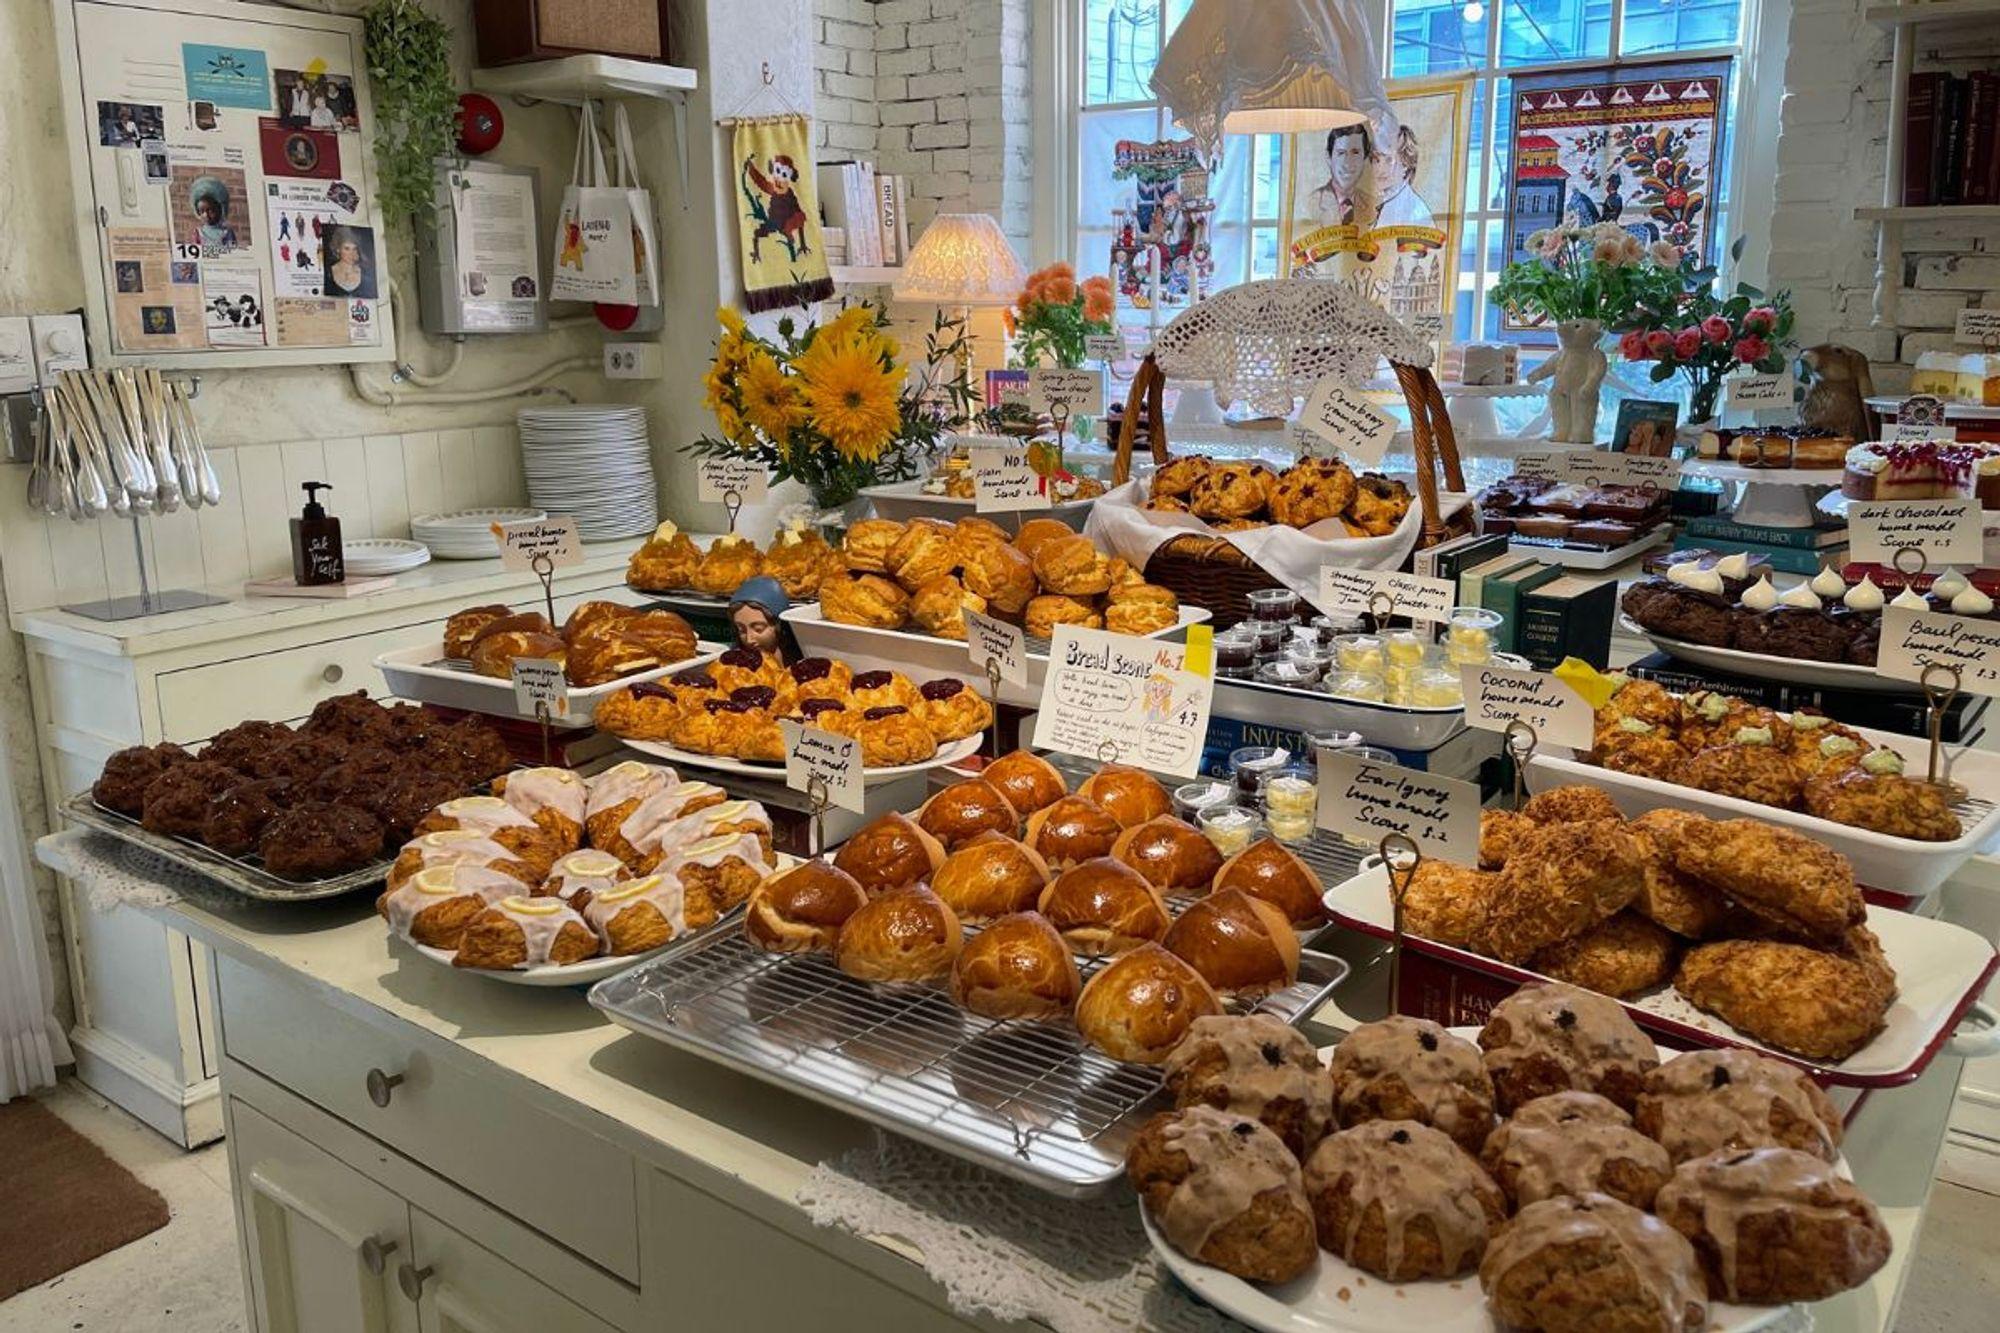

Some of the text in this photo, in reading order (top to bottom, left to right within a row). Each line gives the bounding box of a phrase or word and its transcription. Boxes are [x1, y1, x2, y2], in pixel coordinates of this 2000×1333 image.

[883, 184, 893, 228] BREAD
[177, 244, 200, 259] 19
[1860, 508, 1891, 519] dark
[1878, 520, 1956, 532] home made
[1909, 619, 1964, 638] Basil
[1066, 640, 1110, 671] Bread
[1480, 671, 1544, 693] Coconut
[1480, 703, 1520, 720] Scone
[801, 728, 835, 754] Lemon
[1355, 764, 1450, 804] Earlgrey
[1345, 785, 1450, 823] home made
[1355, 806, 1411, 834] Scone
